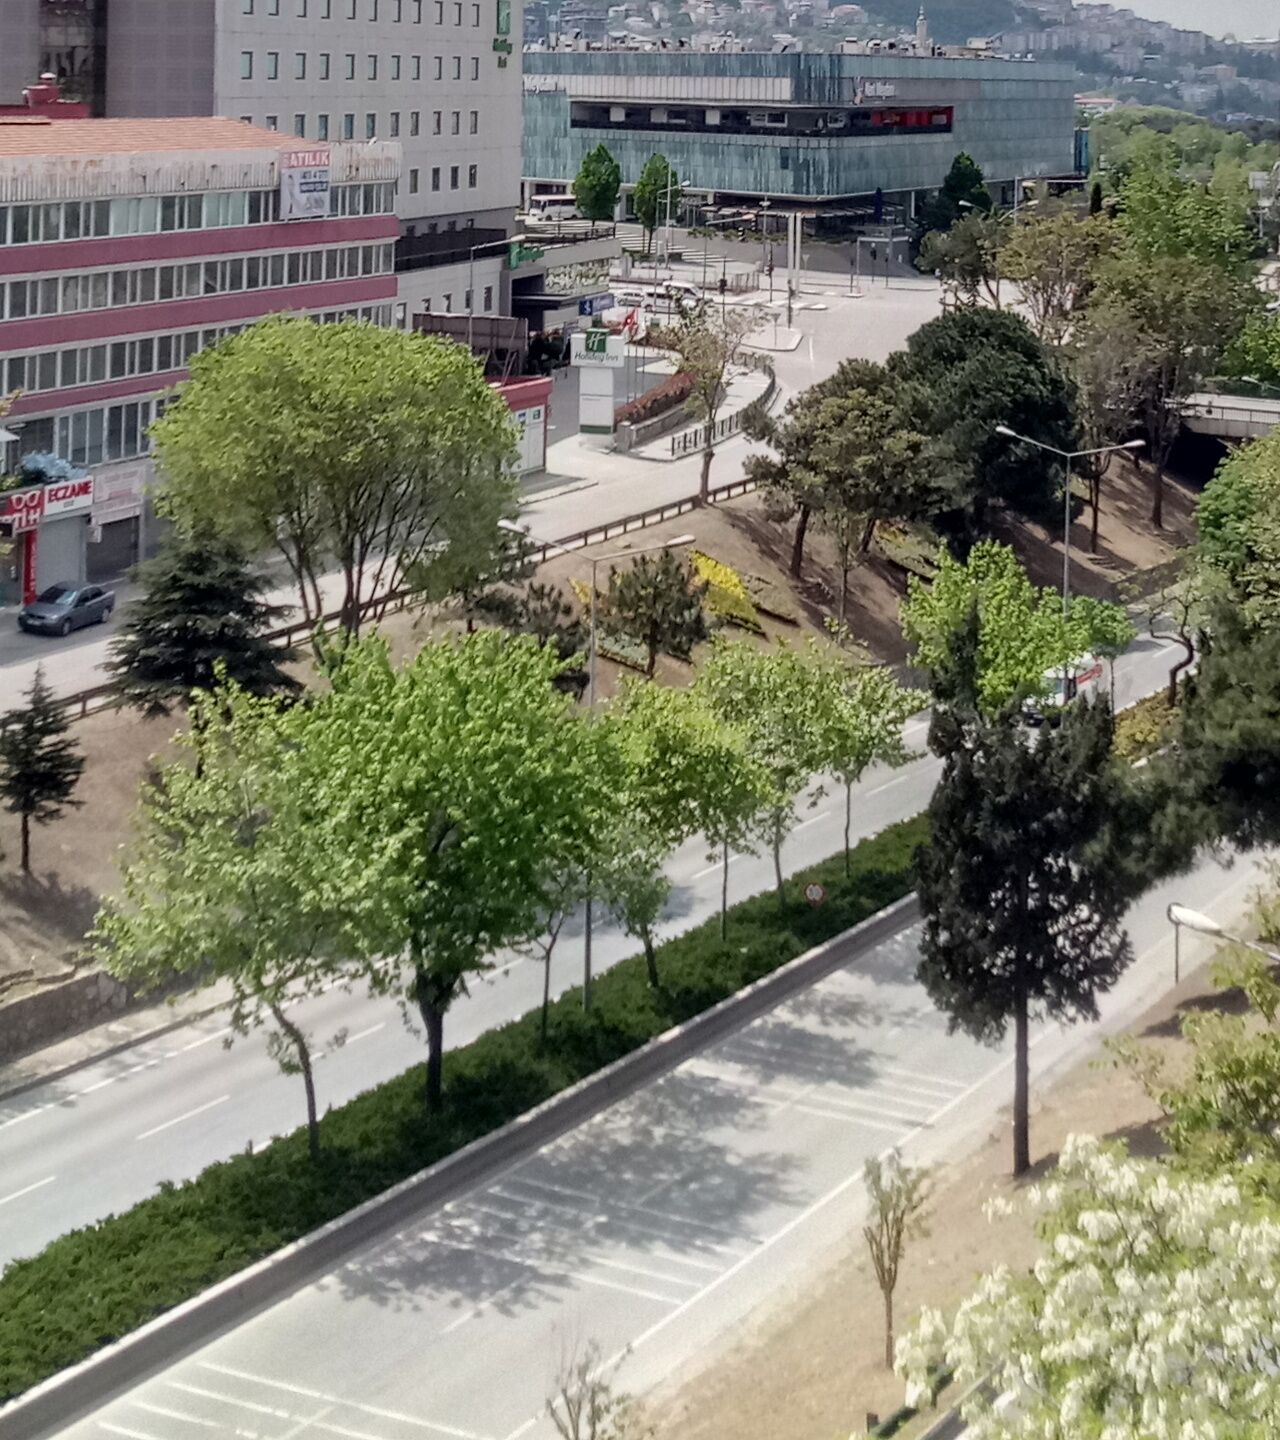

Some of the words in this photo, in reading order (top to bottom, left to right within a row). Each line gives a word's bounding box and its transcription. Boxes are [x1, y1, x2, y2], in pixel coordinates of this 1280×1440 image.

[574, 352, 604, 362] Holiday
[605, 352, 619, 361] Inn
[48, 480, 92, 504] ECZANE
